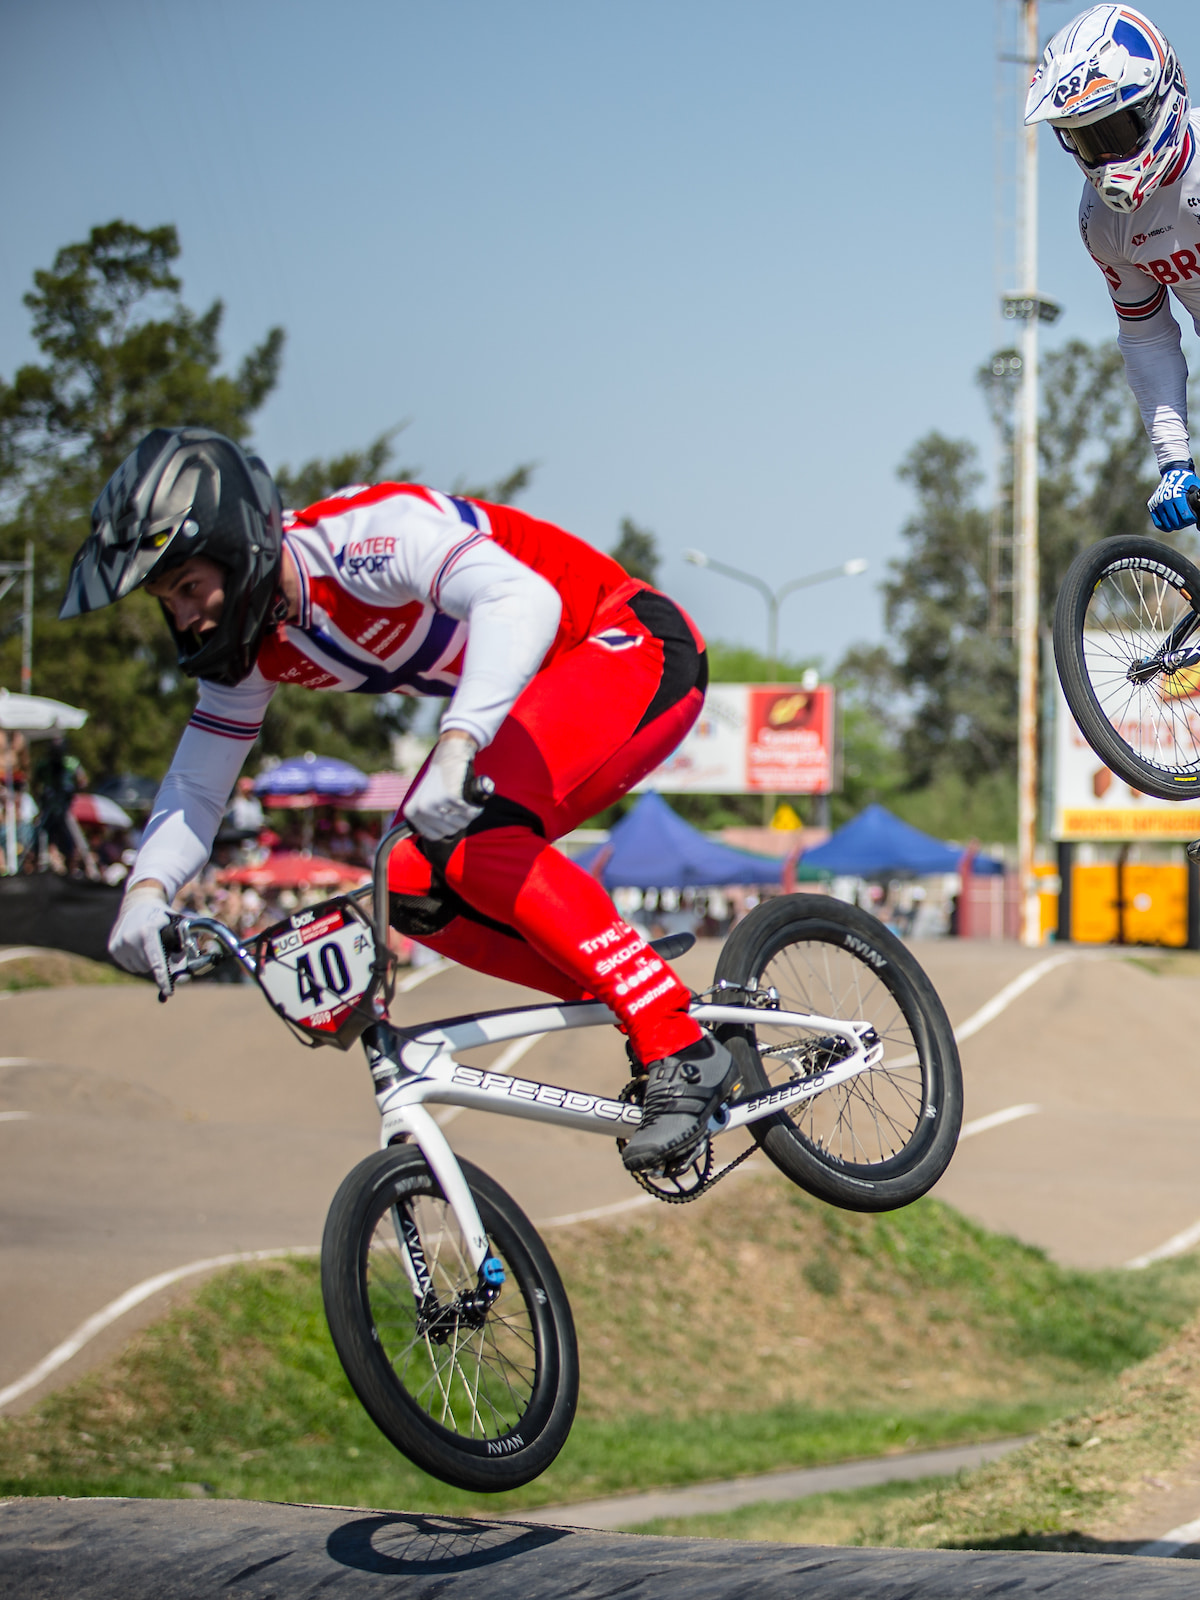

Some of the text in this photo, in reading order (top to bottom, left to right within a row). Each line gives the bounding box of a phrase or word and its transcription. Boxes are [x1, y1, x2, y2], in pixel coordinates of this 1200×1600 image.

[350, 537, 396, 557] INTER
[349, 554, 395, 576] SPORT
[291, 910, 316, 929] box
[278, 933, 301, 952] UCI
[579, 928, 621, 955] Tryg
[296, 941, 352, 1007] 40
[626, 976, 677, 1016] postnord
[309, 1011, 333, 1028] 2019
[451, 1064, 644, 1126] SPEEDCO
[747, 1076, 825, 1114] SPEEDCO
[486, 1432, 526, 1455] AVIAN
